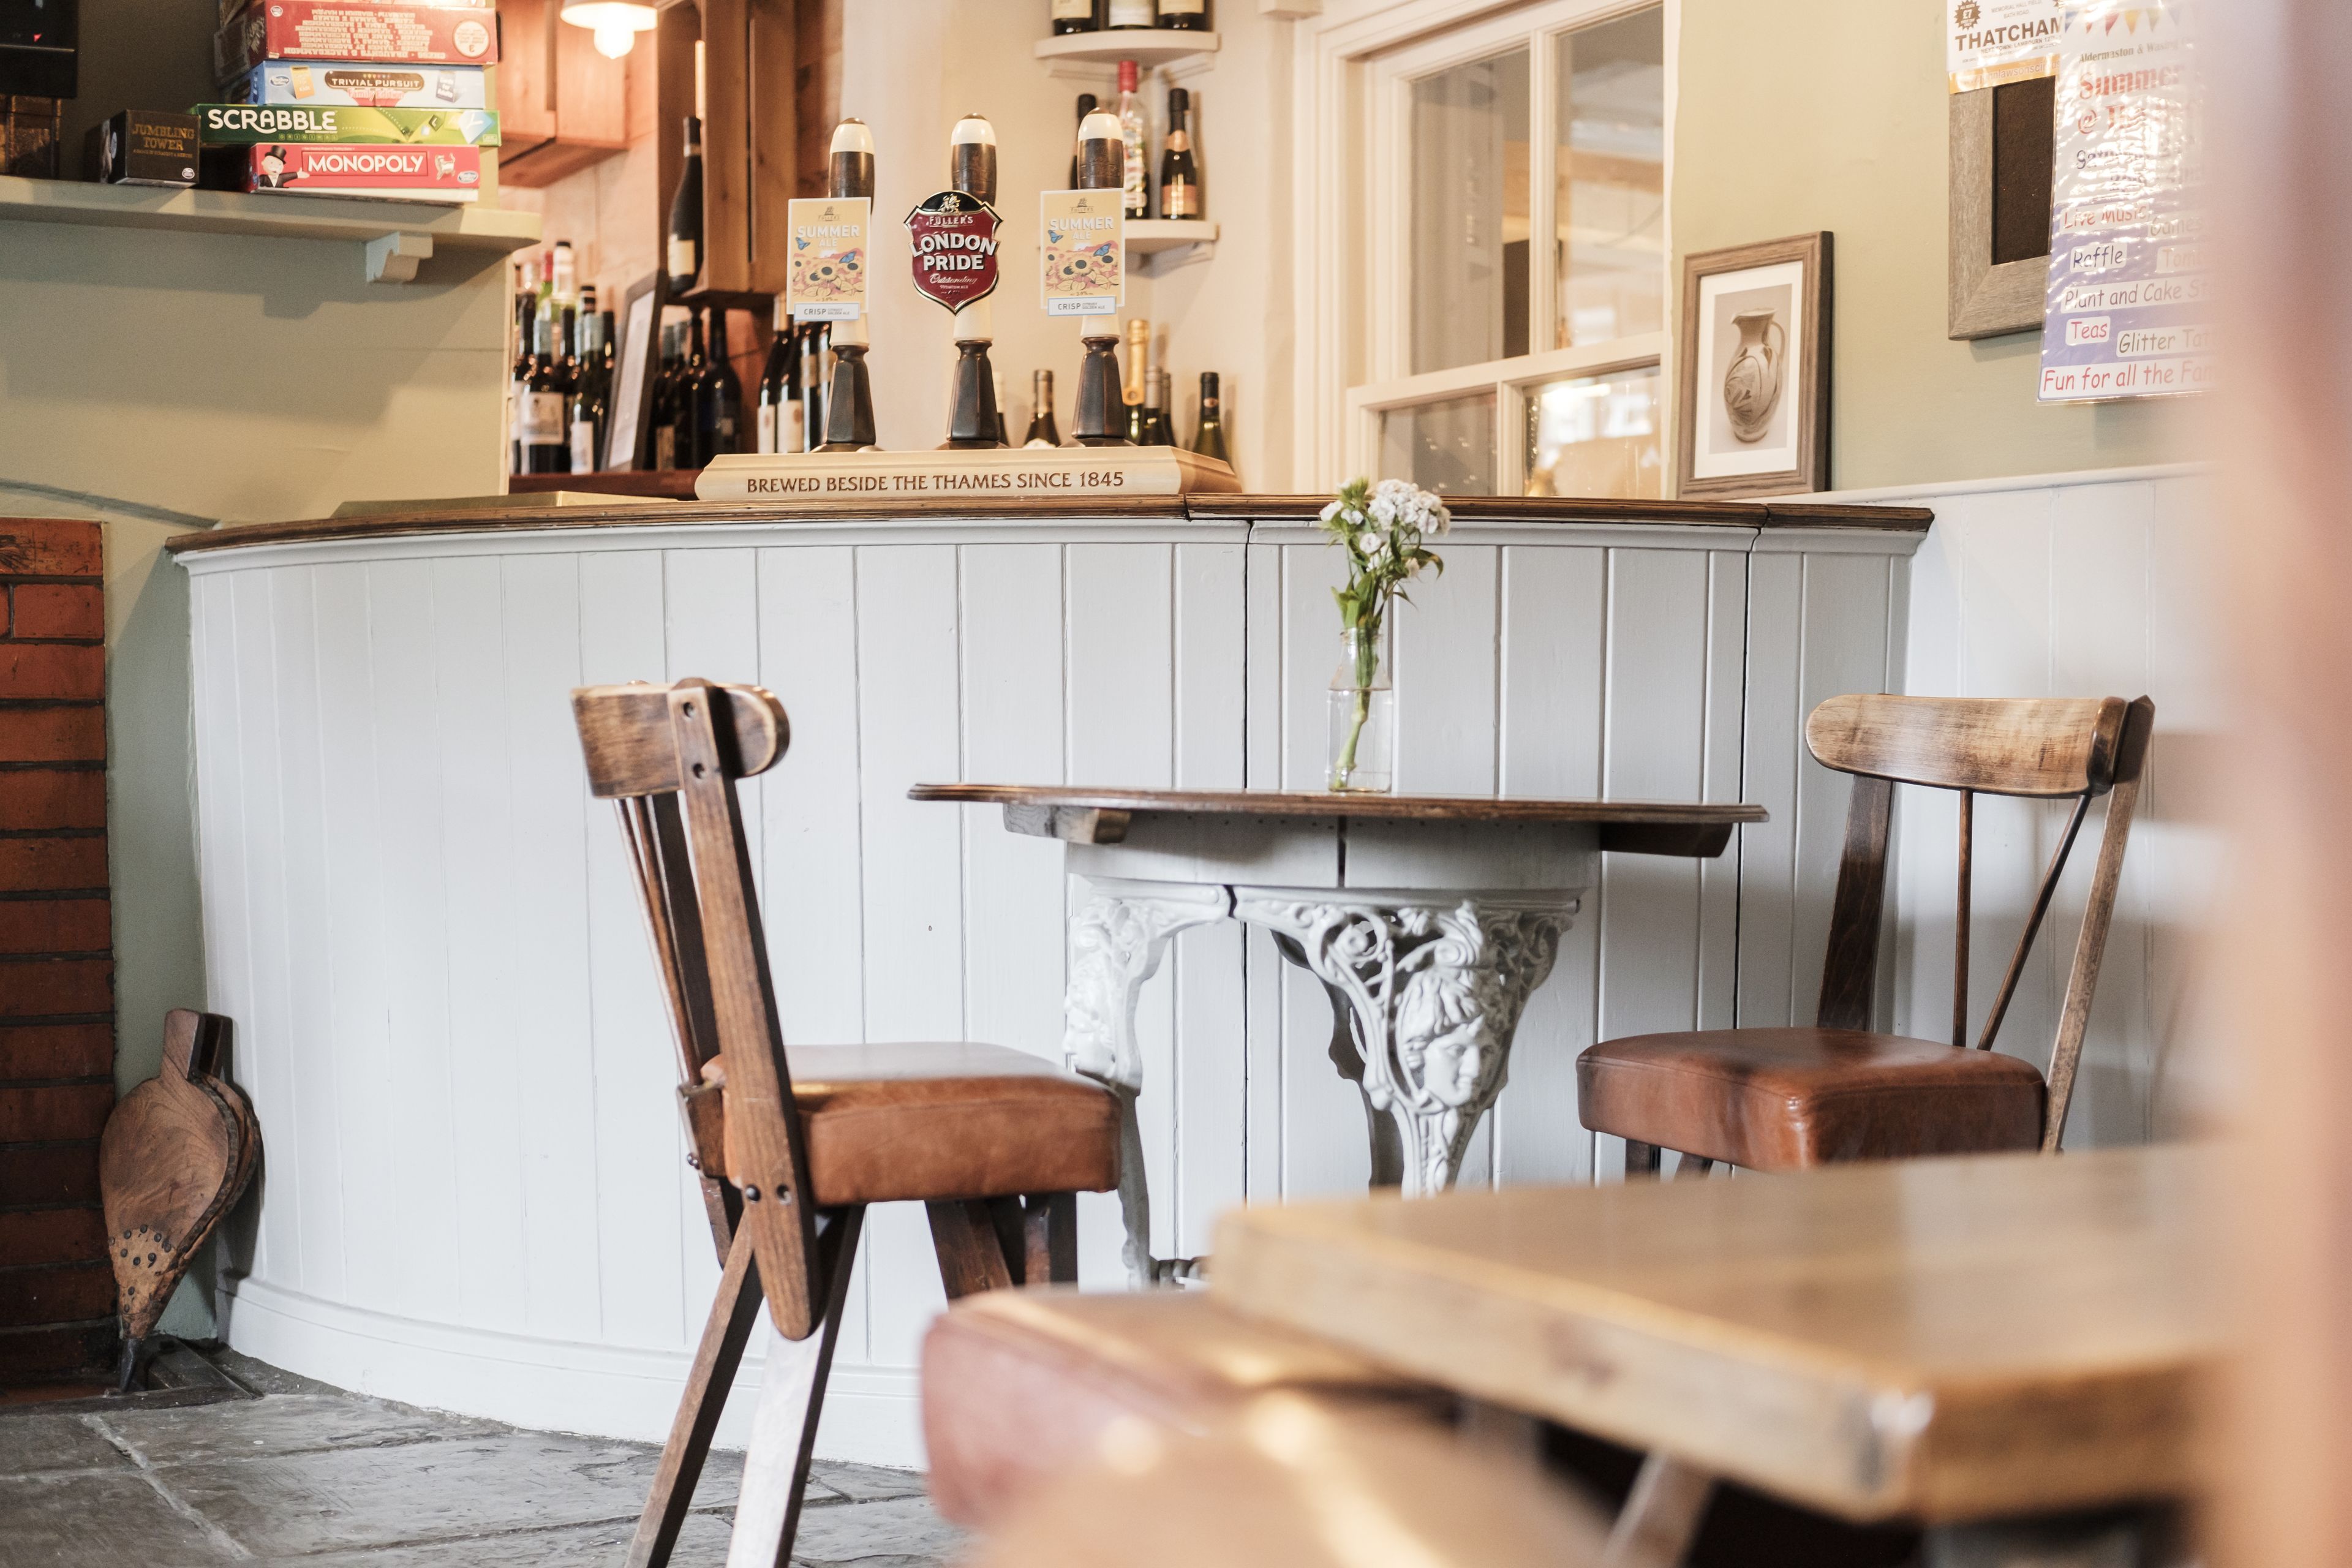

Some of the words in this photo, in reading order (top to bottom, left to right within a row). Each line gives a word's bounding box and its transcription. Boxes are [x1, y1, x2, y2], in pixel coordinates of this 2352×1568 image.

[2079, 47, 2134, 62] Aldermaston
[2137, 44, 2144, 54] &
[331, 78, 373, 87] TRIVIAL
[2079, 65, 2185, 100] Summer
[347, 87, 375, 102] Family
[209, 109, 337, 134] SCRABBLE
[132, 124, 195, 140] JUMBLING
[143, 137, 184, 151] TOWER
[308, 155, 423, 173] MONOPOLY
[929, 215, 974, 225] FULLER'S
[1049, 216, 1114, 232] SUMMER
[2064, 211, 2096, 230] Live
[797, 225, 860, 238] SUMMER
[1072, 231, 1091, 240] ALE
[819, 239, 838, 247] ALE
[909, 232, 997, 258] LONDON
[923, 254, 984, 271] PRIDE
[2073, 245, 2124, 269] Raffle
[2065, 290, 2105, 310] Plant
[2109, 283, 2138, 305] and
[2143, 281, 2182, 302] Cake
[2071, 321, 2108, 339] Teas
[2119, 332, 2176, 353] Glitter
[2043, 369, 2075, 392] Fun
[2082, 366, 2110, 391] for
[2116, 363, 2136, 387] all
[2144, 362, 2174, 385] the
[747, 477, 821, 493] BREWED
[826, 476, 888, 491] BESIDE
[892, 475, 928, 490] THE
[932, 473, 1011, 490] THAMES
[1017, 472, 1072, 488] SINCE
[1079, 471, 1124, 487] 1845
